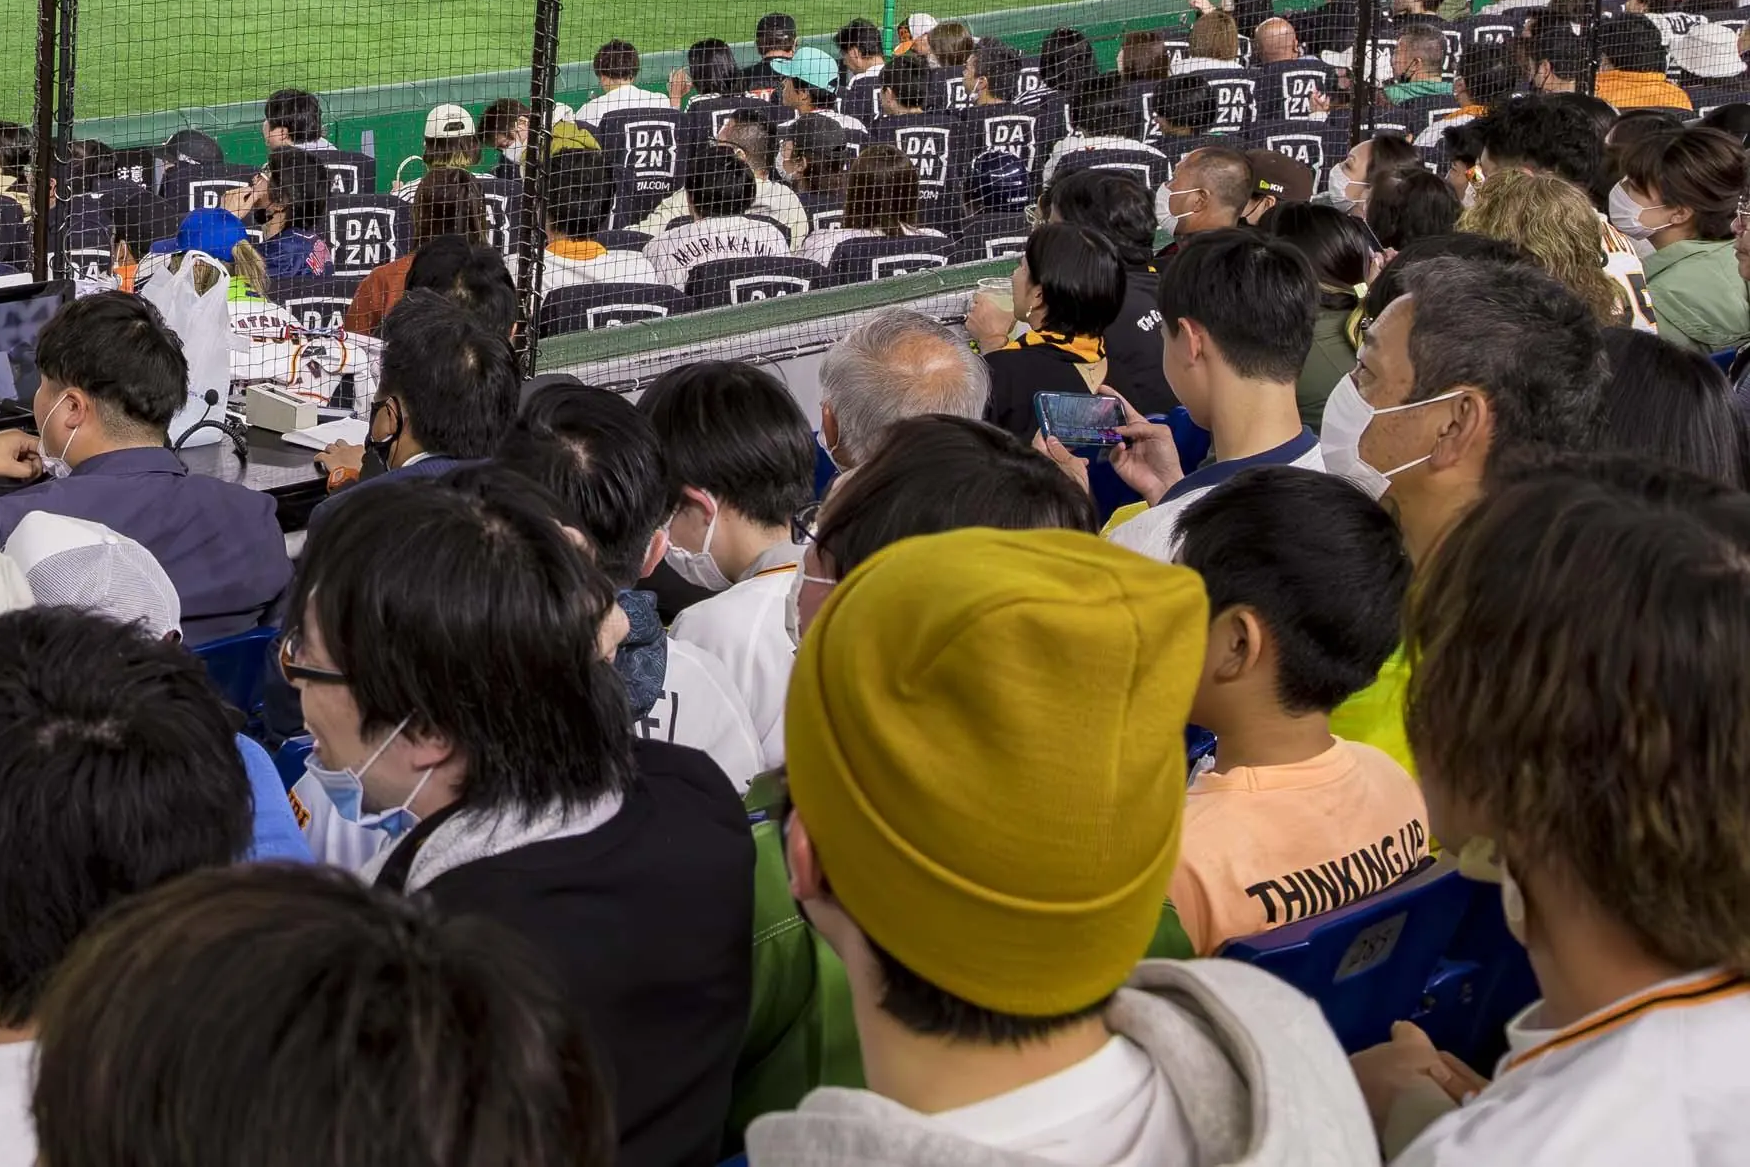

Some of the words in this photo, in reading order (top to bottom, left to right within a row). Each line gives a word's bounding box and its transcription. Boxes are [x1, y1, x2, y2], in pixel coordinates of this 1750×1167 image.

[1218, 88, 1247, 106] DA
[1216, 108, 1244, 123] ZN
[636, 130, 664, 148] DA
[994, 124, 1025, 143] DA
[906, 136, 937, 156] DA
[634, 151, 663, 168] ZN
[1270, 183, 1284, 193] KH
[345, 219, 384, 241] DA
[344, 244, 383, 265] ZN
[671, 235, 773, 267] MURAKAMI
[1245, 835, 1405, 924] THINKING
